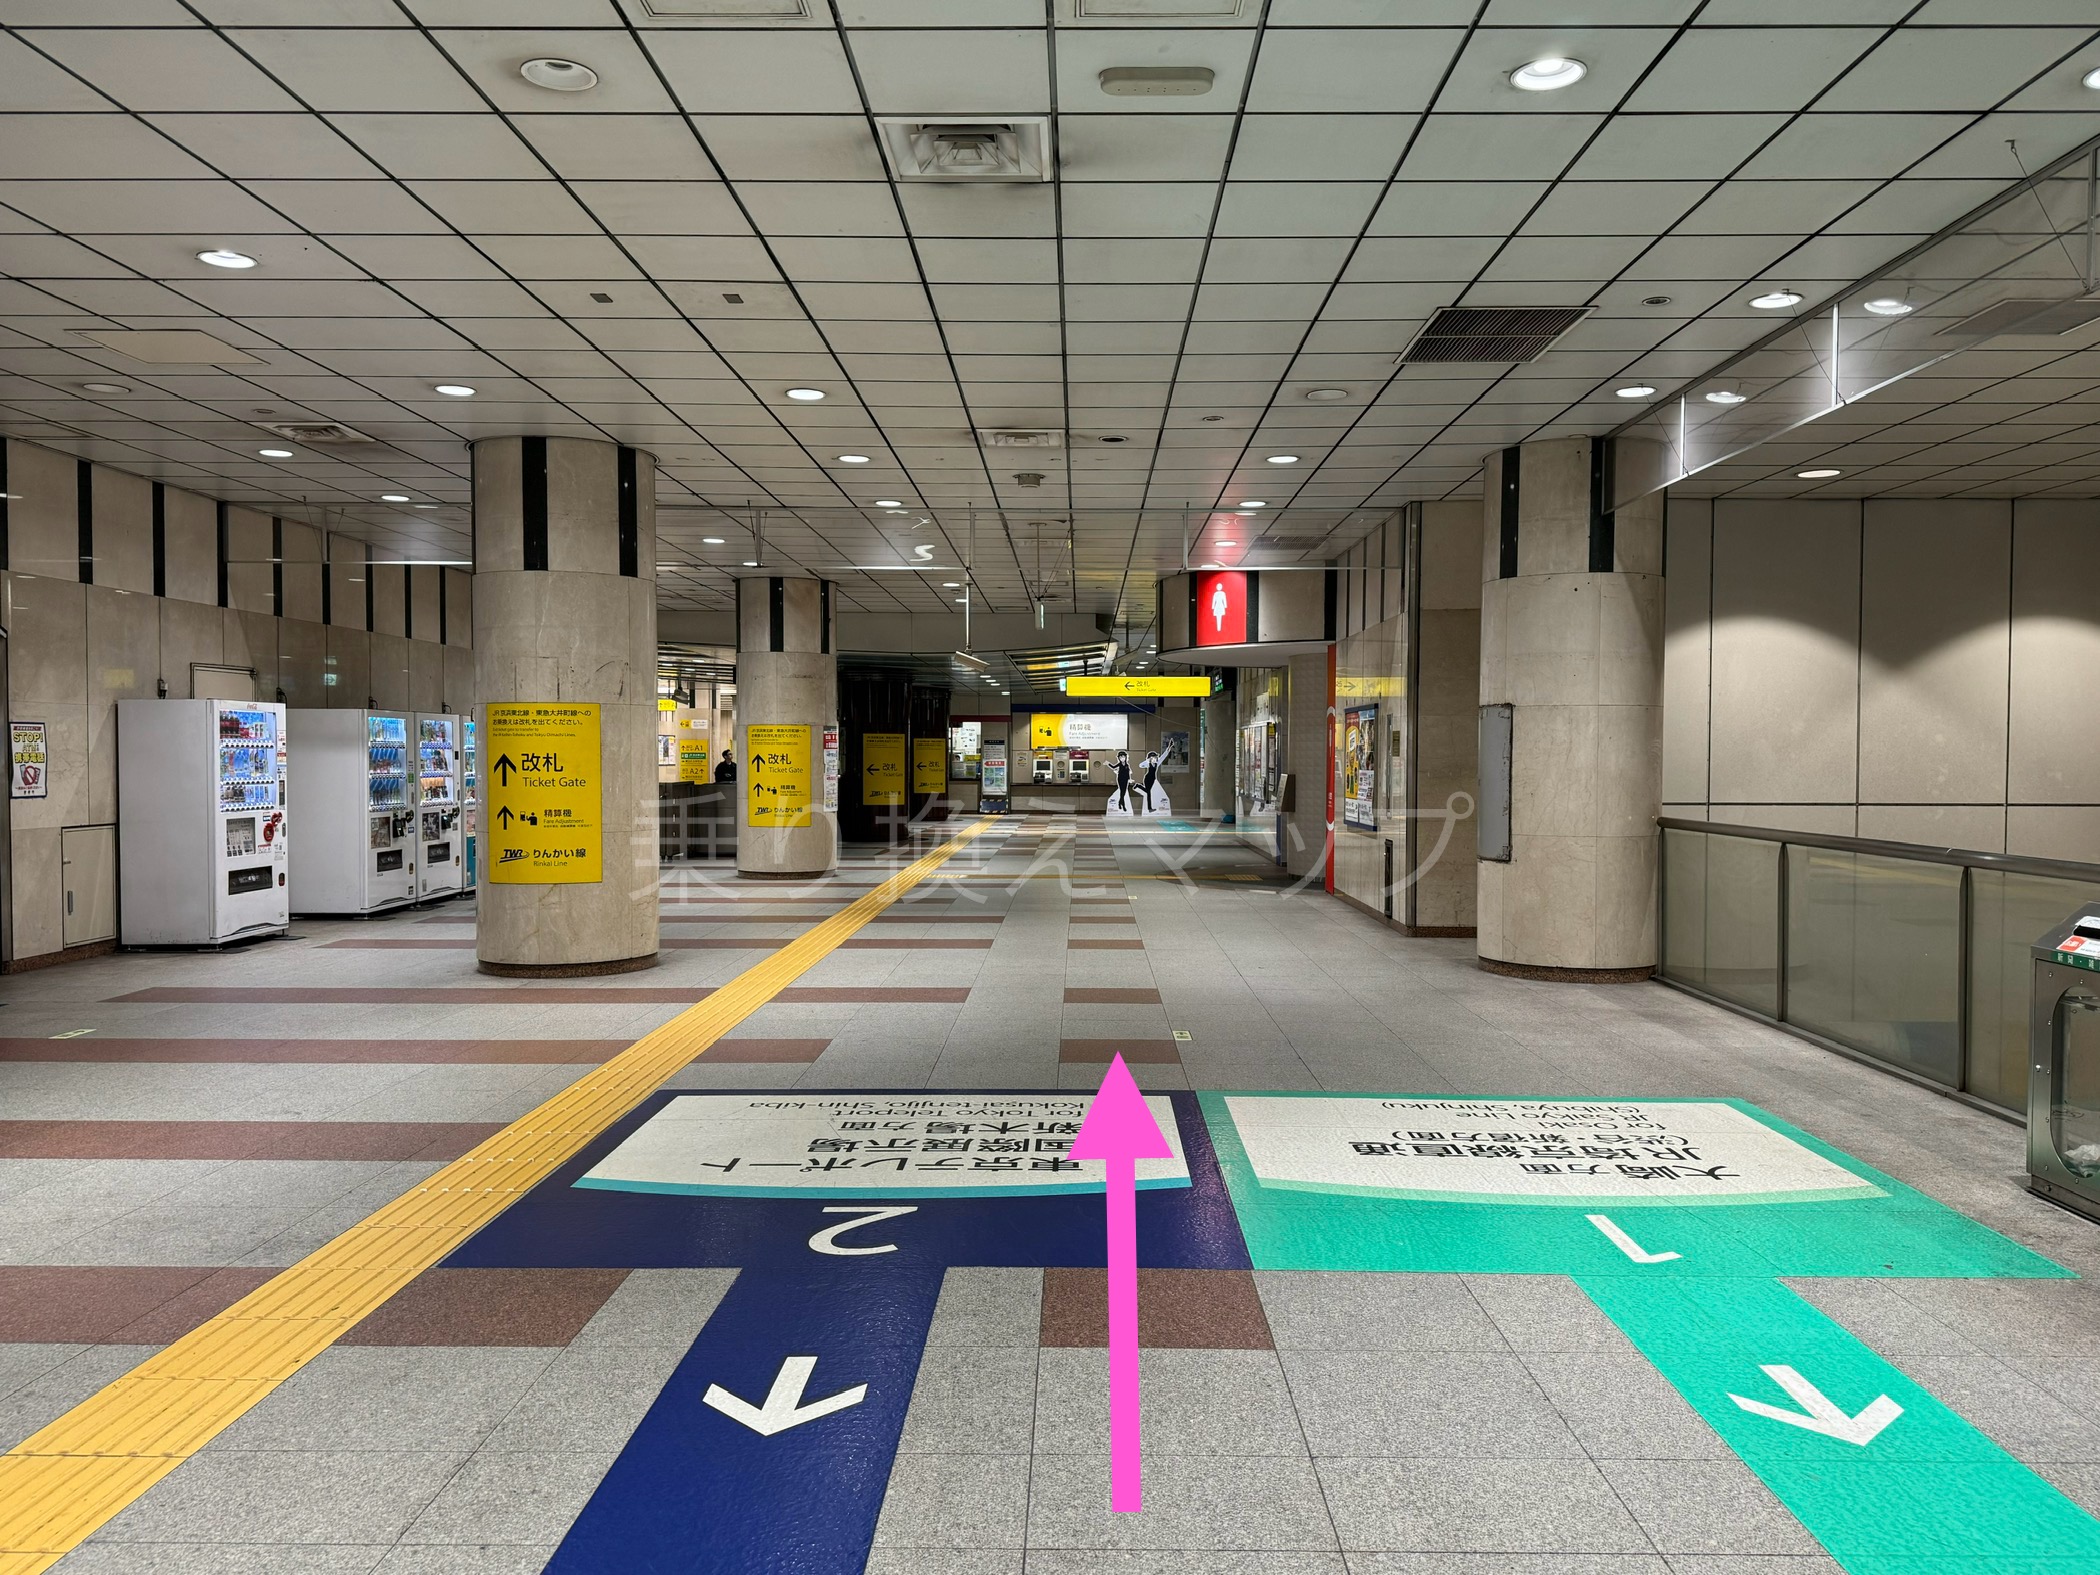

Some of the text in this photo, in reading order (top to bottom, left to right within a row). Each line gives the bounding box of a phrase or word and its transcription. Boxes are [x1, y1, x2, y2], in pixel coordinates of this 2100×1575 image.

[13, 732, 43, 742] STOP!
[521, 752, 563, 772] 改札
[768, 753, 792, 765] 改札
[882, 763, 897, 771] 改札
[523, 777, 586, 787] Ticket Gate
[544, 809, 572, 817] 精算機
[533, 848, 587, 858] りんかい線
[749, 1101, 876, 1109] Shin-kiba
[1381, 1101, 1641, 1113] (Shibuya, Shinjuku)
[832, 1109, 946, 1117] Teleport
[955, 1108, 1034, 1117] Tokyo
[1456, 1112, 1514, 1120] Line
[1521, 1112, 1615, 1121] Saikyo
[1537, 1121, 1667, 1130] for Osaki
[807, 1138, 1075, 1153] 国際展示場
[699, 1156, 1084, 1173] 東京テレポート
[805, 1205, 920, 1256] 2
[1583, 1214, 1684, 1264] 1
